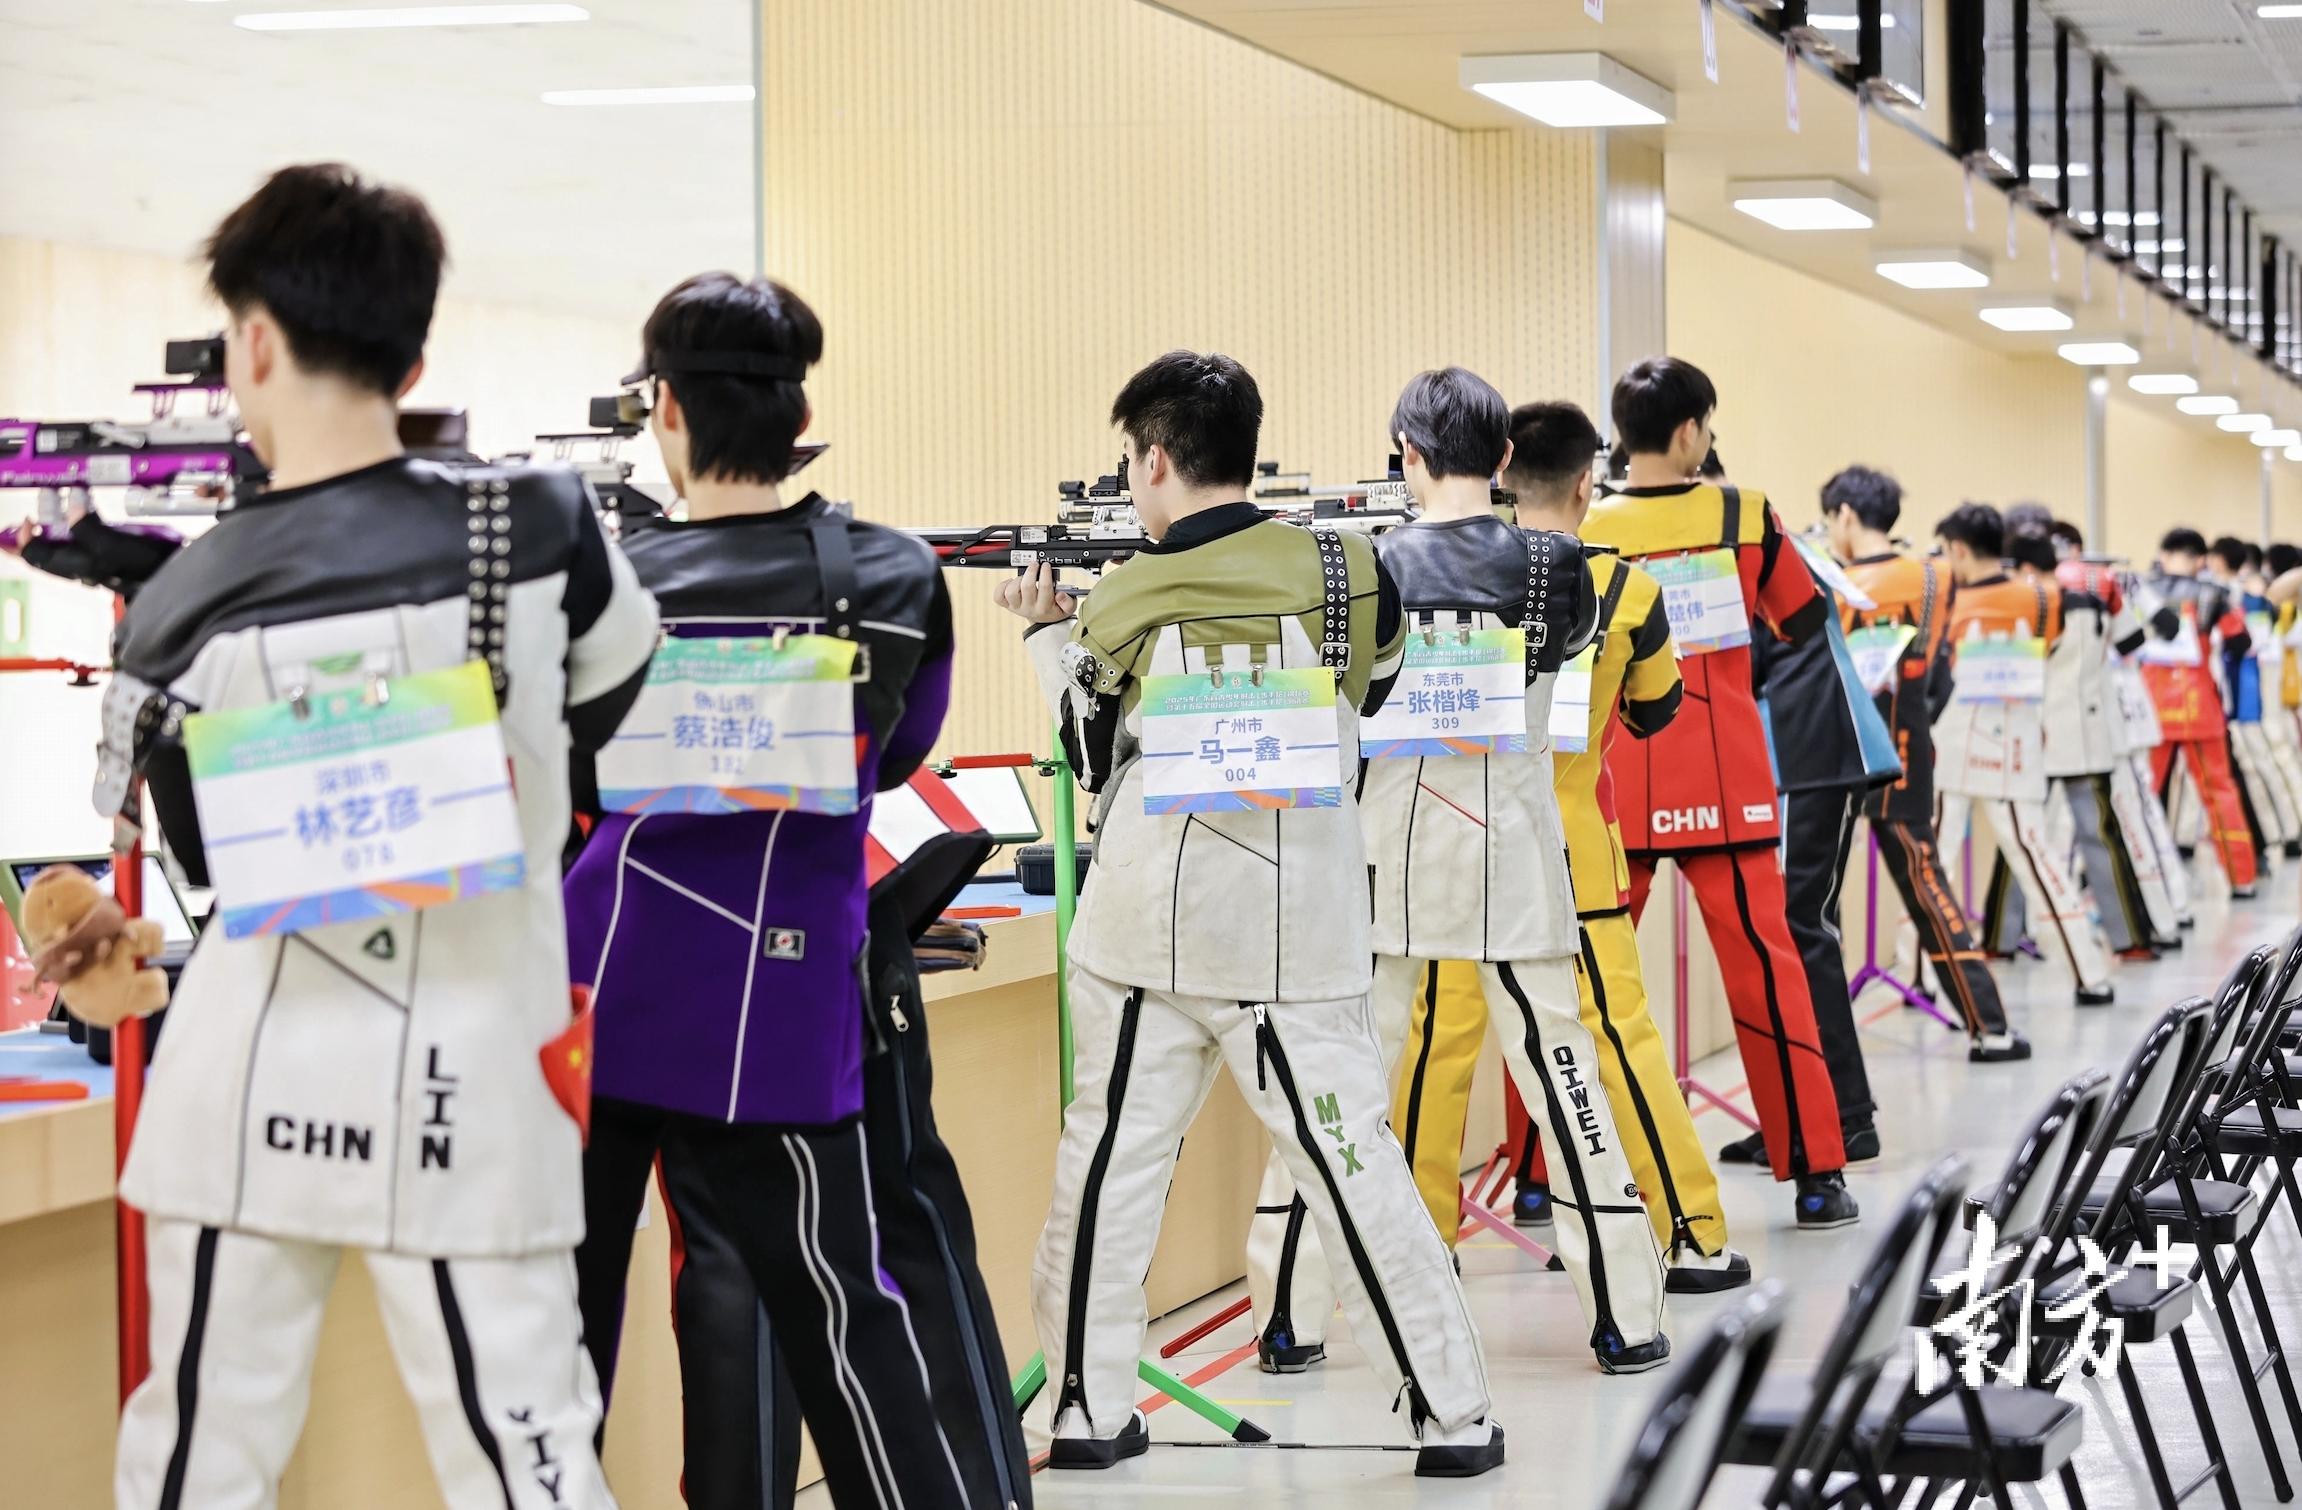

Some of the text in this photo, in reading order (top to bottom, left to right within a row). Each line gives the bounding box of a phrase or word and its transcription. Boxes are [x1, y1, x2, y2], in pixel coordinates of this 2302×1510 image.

[1663, 589, 1691, 601] 莞市
[1667, 601, 1704, 622] 楚伟
[1422, 672, 1464, 687] 东莞市
[694, 691, 755, 713] 佛山市
[1408, 689, 1480, 714] 张楷烽
[673, 715, 776, 750] 蔡浩俊
[1215, 717, 1263, 735] 广州市
[1432, 717, 1459, 729] 309
[1199, 735, 1281, 765] 马一鑫
[315, 759, 393, 795] 深圳市
[1225, 768, 1257, 782] 004
[295, 785, 423, 849] 林艺彦
[1652, 805, 1719, 834] CHN
[421, 1046, 458, 1169] LIN
[1552, 1045, 1607, 1157] QIWEI
[266, 1116, 372, 1161] CHN
[1313, 1092, 1365, 1178] MYX
